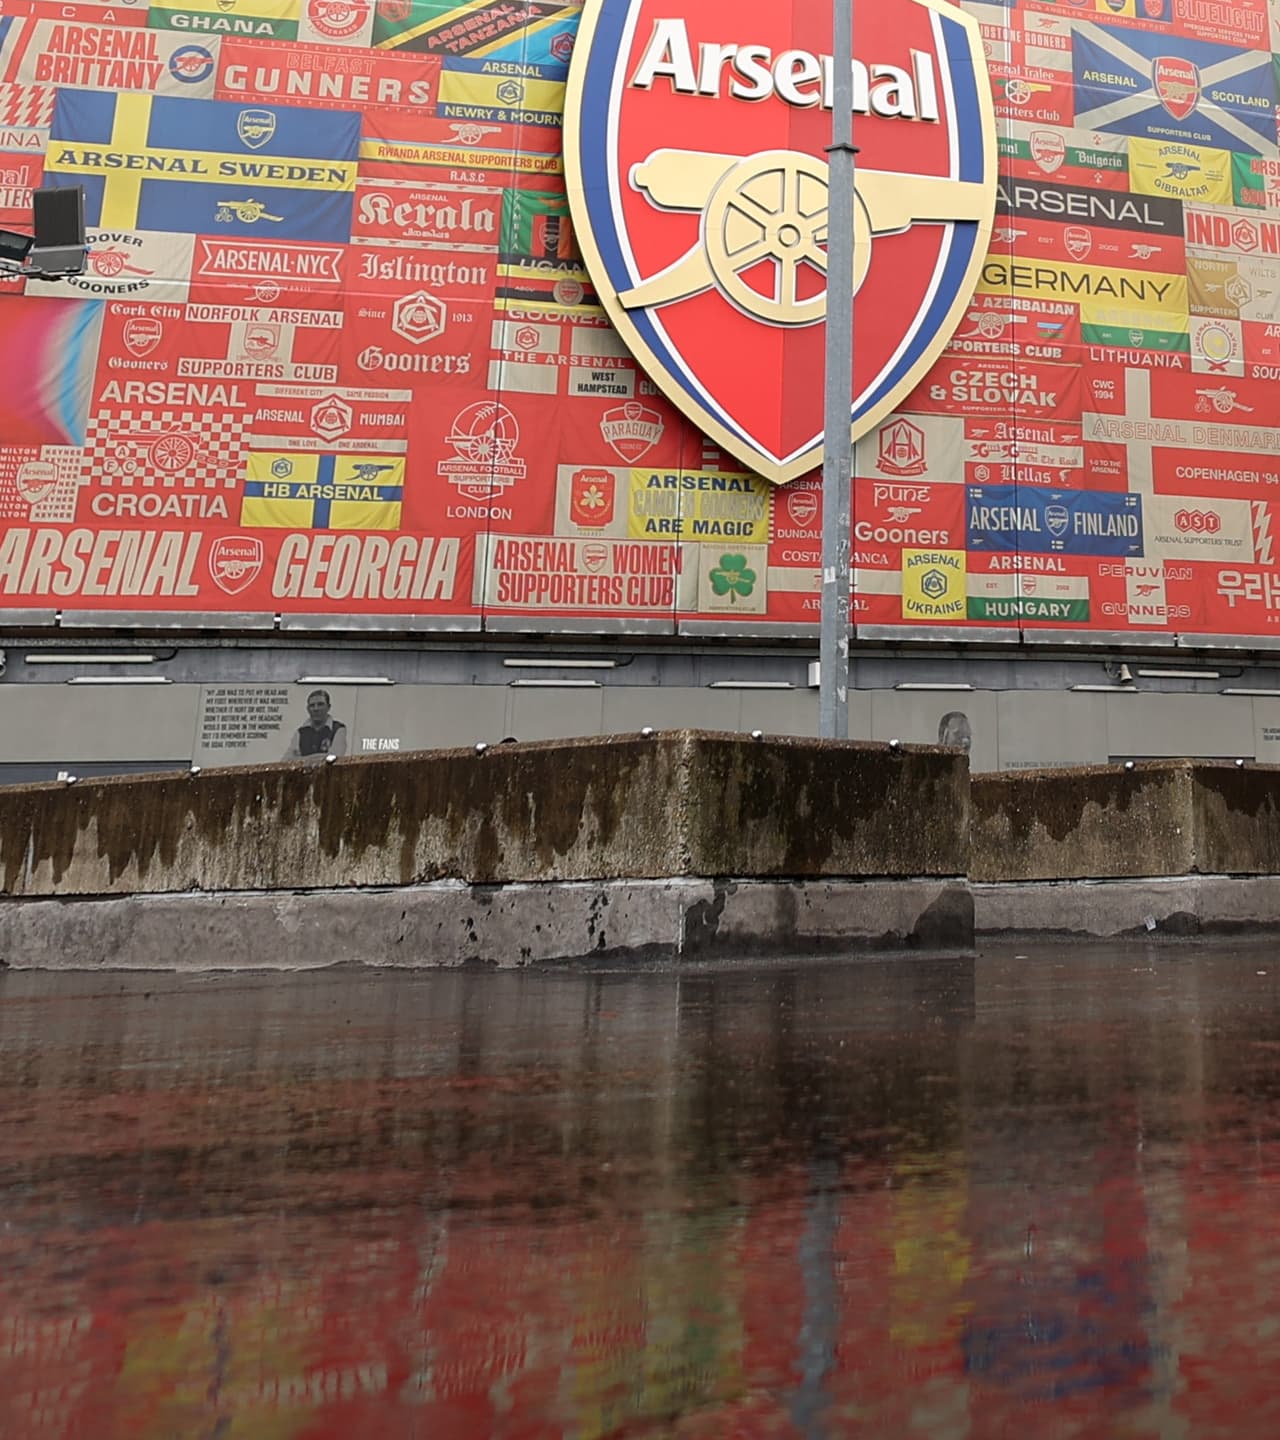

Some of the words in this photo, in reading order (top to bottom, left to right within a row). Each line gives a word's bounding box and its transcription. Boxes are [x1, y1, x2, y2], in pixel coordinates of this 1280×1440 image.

[171, 14, 275, 35] GHANA
[46, 26, 159, 61] ARSENAL
[36, 60, 163, 89] BRITTANY
[629, 19, 939, 122] Arsenal
[1083, 70, 1137, 88] ARSENAL
[1211, 90, 1269, 108] SCOTLAND
[57, 150, 208, 174] ARSENAL
[219, 161, 347, 184] SWEDEN
[378, 146, 420, 160] RWANDA
[423, 150, 467, 164] ARSENAL
[470, 154, 531, 168] SUPPORTERS
[534, 158, 558, 171] CLUB
[358, 193, 495, 232] Kerala
[994, 186, 1163, 225] ARSENAL
[360, 254, 487, 285] Islington
[982, 264, 1170, 302] GERMANY
[187, 307, 259, 322] NORFOLK
[270, 311, 341, 326] ARSENAL
[452, 312, 472, 322] 1913
[180, 362, 285, 377] SUPPORTERS
[293, 365, 335, 380] CLUB
[357, 345, 471, 373] Gooners
[577, 382, 627, 394] HAMPSTEAD
[592, 371, 616, 382] WEST
[1093, 379, 1114, 390] CWC
[99, 380, 247, 408] ARSENAL
[1094, 390, 1114, 400] 1994
[255, 408, 304, 422] ARSENAL
[360, 413, 405, 426] MUMBAI
[92, 494, 229, 518] CROATIA
[970, 506, 1041, 533] ARSENAL
[1074, 512, 1138, 537] FINLAND
[272, 533, 461, 600] GEORGIA
[494, 541, 578, 572] ARSENAL
[613, 545, 682, 574] WOMEN
[989, 555, 1066, 572] ARSENAL
[498, 575, 623, 605] SUPPORTERS
[627, 578, 674, 606] CLUB
[986, 603, 1071, 617] HUNGARY
[362, 738, 377, 750] THE
[378, 738, 400, 750] FANS
